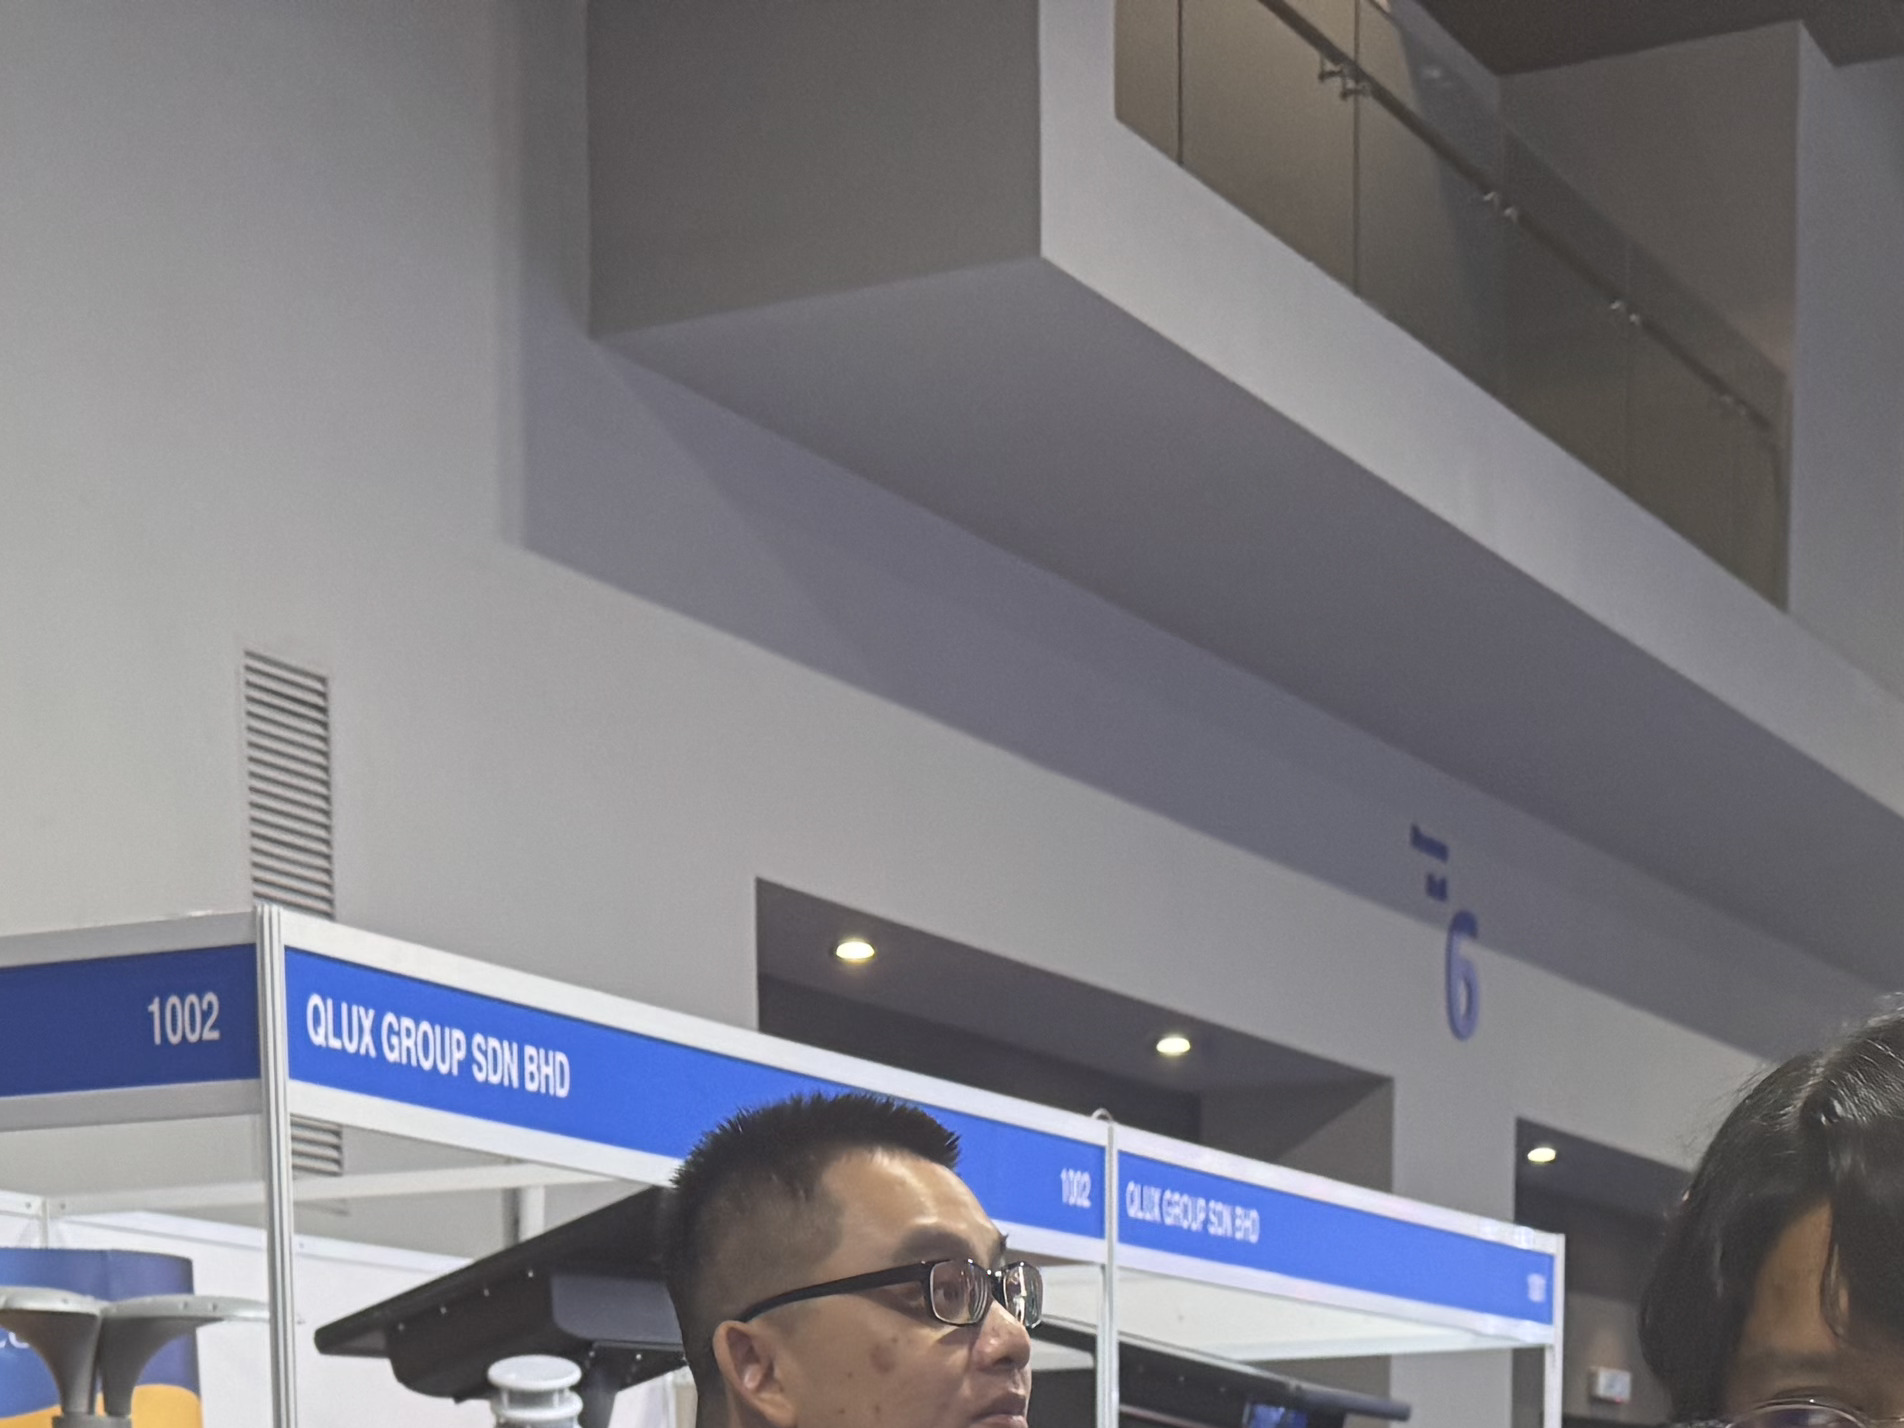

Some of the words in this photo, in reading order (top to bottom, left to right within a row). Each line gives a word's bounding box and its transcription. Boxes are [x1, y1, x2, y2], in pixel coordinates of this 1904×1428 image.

[147, 992, 220, 1046] 1002
[306, 994, 375, 1058] QLUX
[382, 1021, 466, 1078] GROUP
[472, 1034, 518, 1089] SDN
[524, 1052, 570, 1098] BHD
[1126, 1181, 1161, 1223] QLUX
[1163, 1190, 1205, 1231] GROUP
[1208, 1201, 1232, 1237] SDN
[1235, 1208, 1259, 1244] BHD
